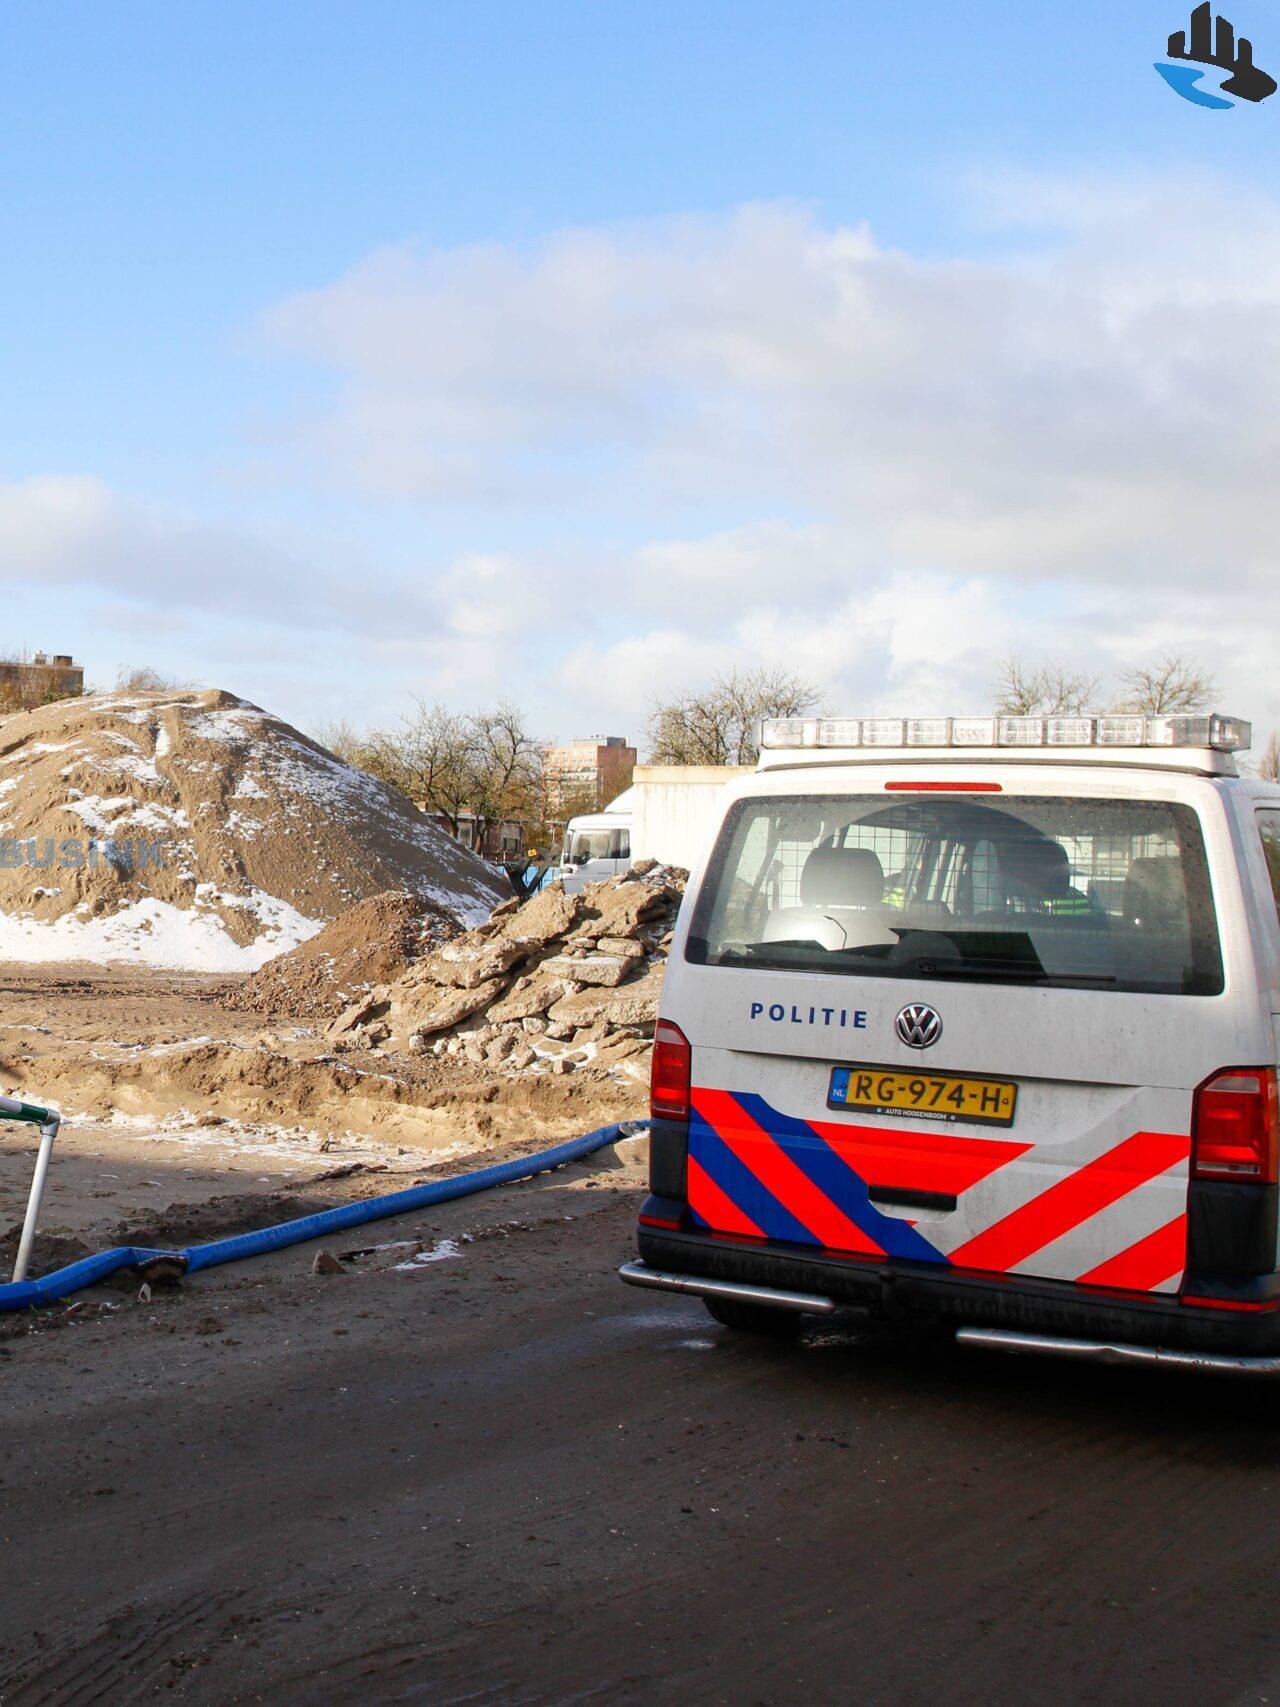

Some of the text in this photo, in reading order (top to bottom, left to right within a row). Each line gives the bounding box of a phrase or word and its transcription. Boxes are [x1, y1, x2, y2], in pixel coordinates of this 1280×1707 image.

[750, 1002, 868, 1029] POLITIE
[832, 1088, 845, 1097] NL
[854, 1074, 1002, 1113] RG-974-H
[885, 1108, 947, 1120] AUTO HOOGENBOOM
